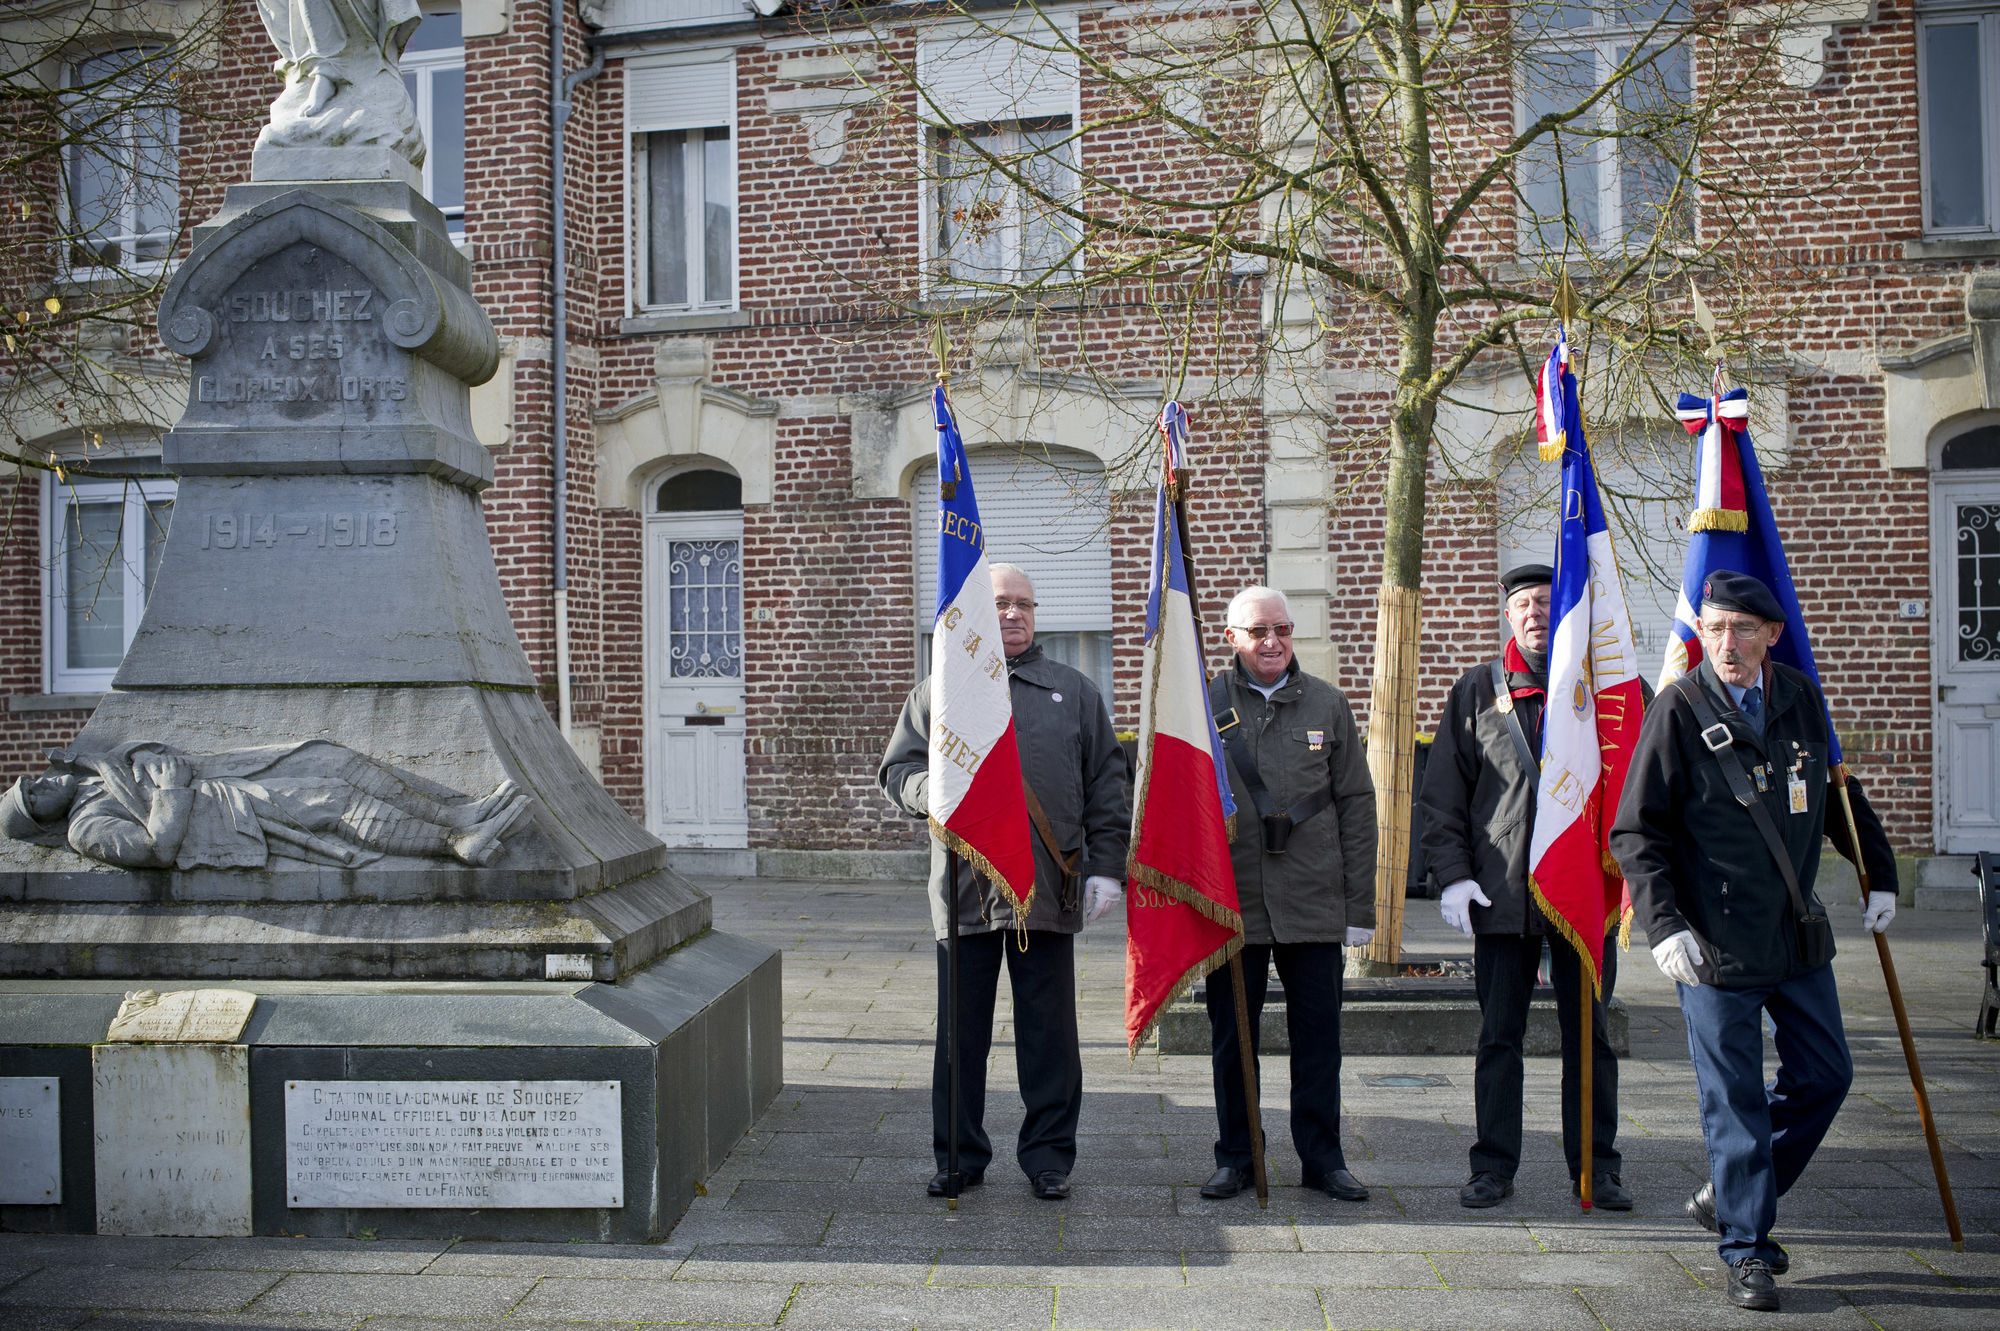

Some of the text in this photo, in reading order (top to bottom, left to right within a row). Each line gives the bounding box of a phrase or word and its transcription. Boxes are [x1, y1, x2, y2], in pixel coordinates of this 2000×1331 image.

[230, 290, 372, 323] SOUCHEZ
[261, 335, 344, 360] A SES
[199, 375, 319, 402] GLORIEUX
[1908, 604, 1917, 614] 85
[933, 717, 981, 777] CHEZ
[314, 1088, 373, 1105] CITATION
[377, 1092, 392, 1105] DE
[486, 1092, 505, 1105] DE
[513, 1089, 583, 1105] SOUCHEZ
[325, 1107, 386, 1121] JOURNAL
[394, 1110, 452, 1121] OFFICIEL
[460, 1111, 476, 1122] DU
[451, 1127, 482, 1137] COURS
[506, 1127, 549, 1137] VIOLENTS
[406, 1142, 425, 1151] SON
[429, 1142, 448, 1151] NOM
[462, 1142, 482, 1151] FAIT
[551, 1157, 563, 1167] ET
[407, 1187, 421, 1196] DE
[441, 1183, 489, 1196] FRANCE
